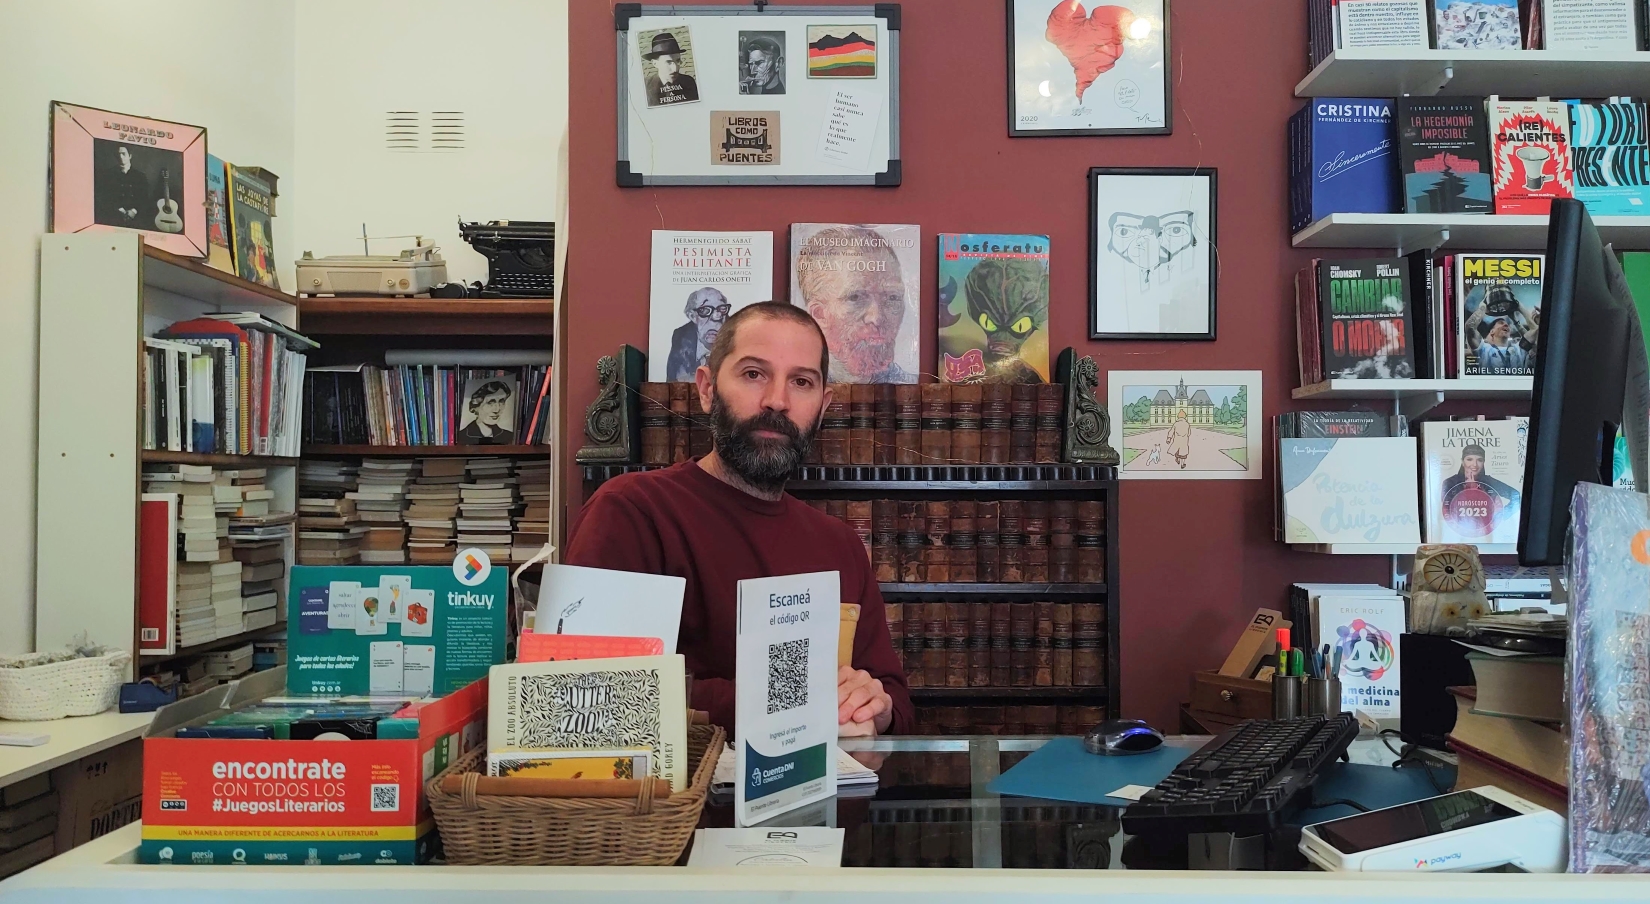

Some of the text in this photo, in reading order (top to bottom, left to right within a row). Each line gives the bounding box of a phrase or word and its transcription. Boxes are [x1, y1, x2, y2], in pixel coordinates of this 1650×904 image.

[1317, 104, 1391, 118] CRISTINA
[727, 116, 768, 127] LIBROS
[1411, 113, 1474, 127] LA HEGEMONÍA
[1519, 119, 1543, 132] (RE)
[103, 121, 174, 140] LEONARDO
[734, 127, 759, 136] COMO
[1421, 128, 1468, 139] IMPOSIBLE
[118, 132, 157, 146] FAVIO
[1497, 133, 1566, 142] CALIENTES
[718, 152, 773, 164] PUENTES
[813, 238, 848, 247] MUSEO
[674, 247, 752, 257] PESIMISTA
[673, 258, 751, 267] MILITANTE
[816, 260, 844, 271] VAN
[847, 261, 887, 272] GOGH
[1464, 259, 1540, 277] MESSI
[1330, 270, 1362, 279] CHOMSKY
[1376, 268, 1400, 277] POLLIN
[1330, 279, 1403, 313] CAMBIAR
[1446, 428, 1493, 438] JIMENA
[1442, 438, 1501, 447] LA TORRE
[1458, 508, 1488, 517] 2023
[447, 591, 494, 610] tinkuy
[769, 589, 811, 608] Escaneá
[769, 611, 810, 625] el código QR
[569, 684, 611, 709] UTTER
[1348, 686, 1399, 696] medicina
[1363, 696, 1390, 706] alma
[507, 676, 516, 746] EL ZOO ABSOLUTO
[664, 743, 673, 769] GOREY
[212, 758, 346, 779] encontrate
[212, 783, 346, 796] CON TODOS LOS
[212, 799, 346, 815] #JuegosLiterarios
[1430, 852, 1462, 865] payway
